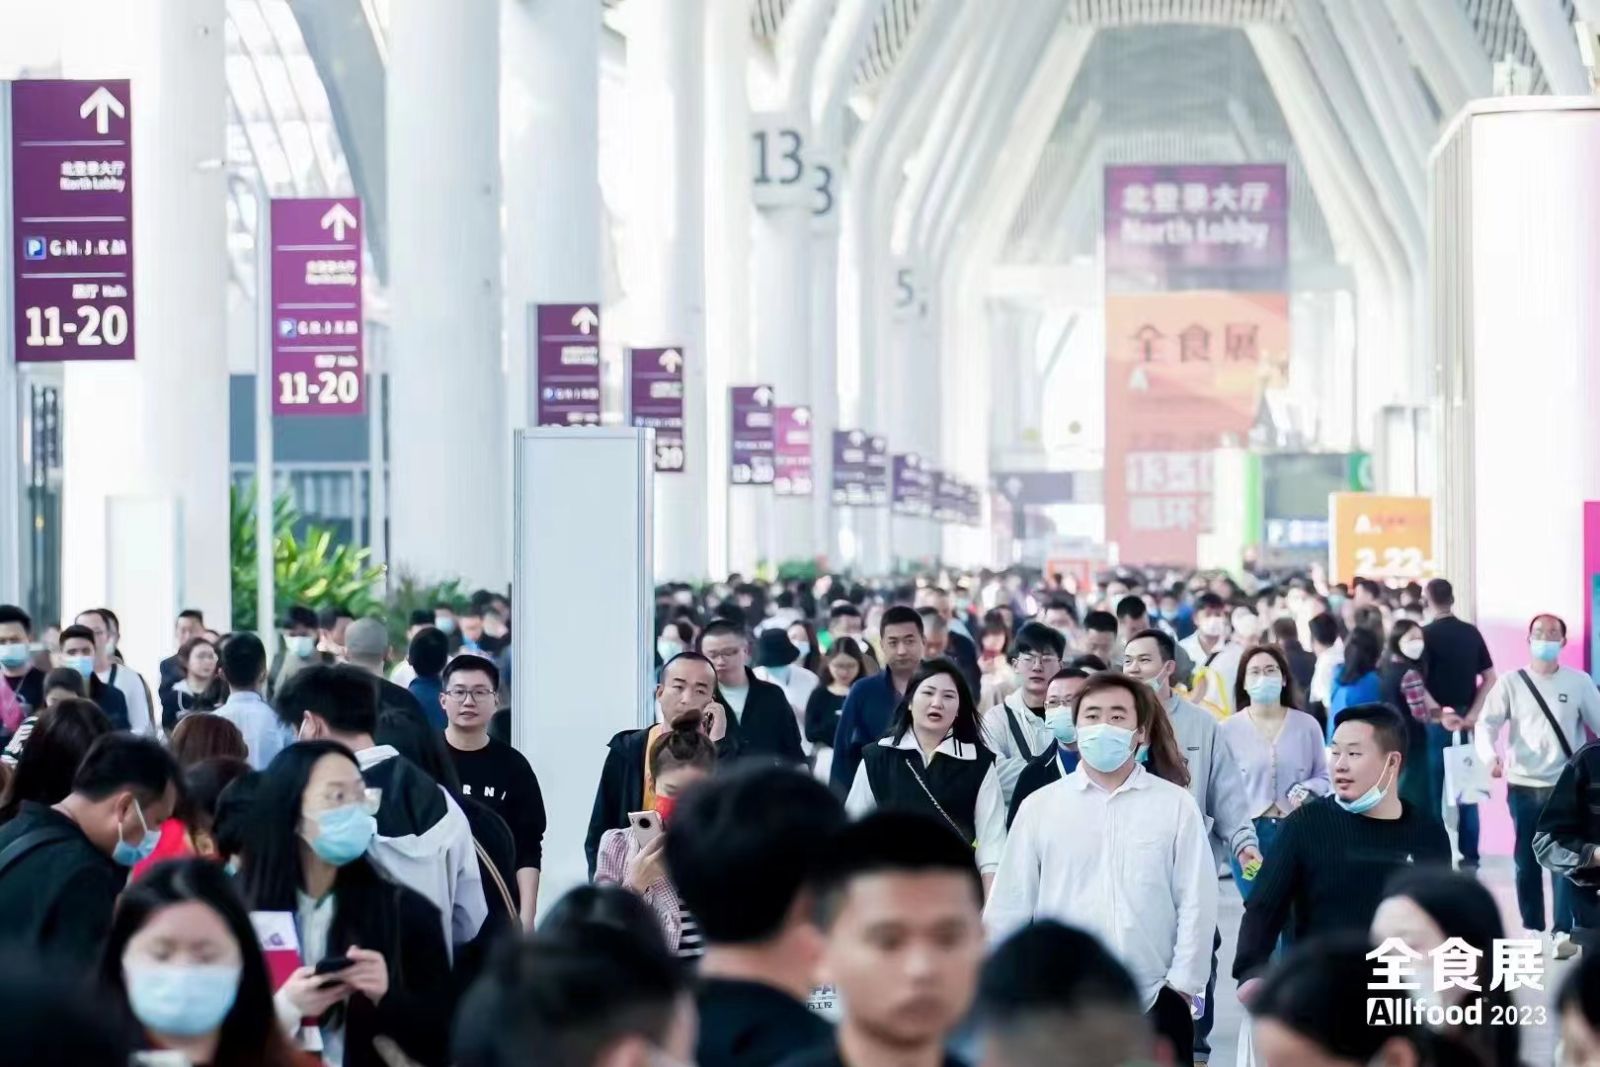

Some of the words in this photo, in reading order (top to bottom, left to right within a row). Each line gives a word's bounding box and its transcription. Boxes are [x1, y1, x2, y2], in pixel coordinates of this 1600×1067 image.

[752, 130, 804, 184] 13
[25, 305, 129, 347] 11-20
[278, 371, 359, 404] 11-20
